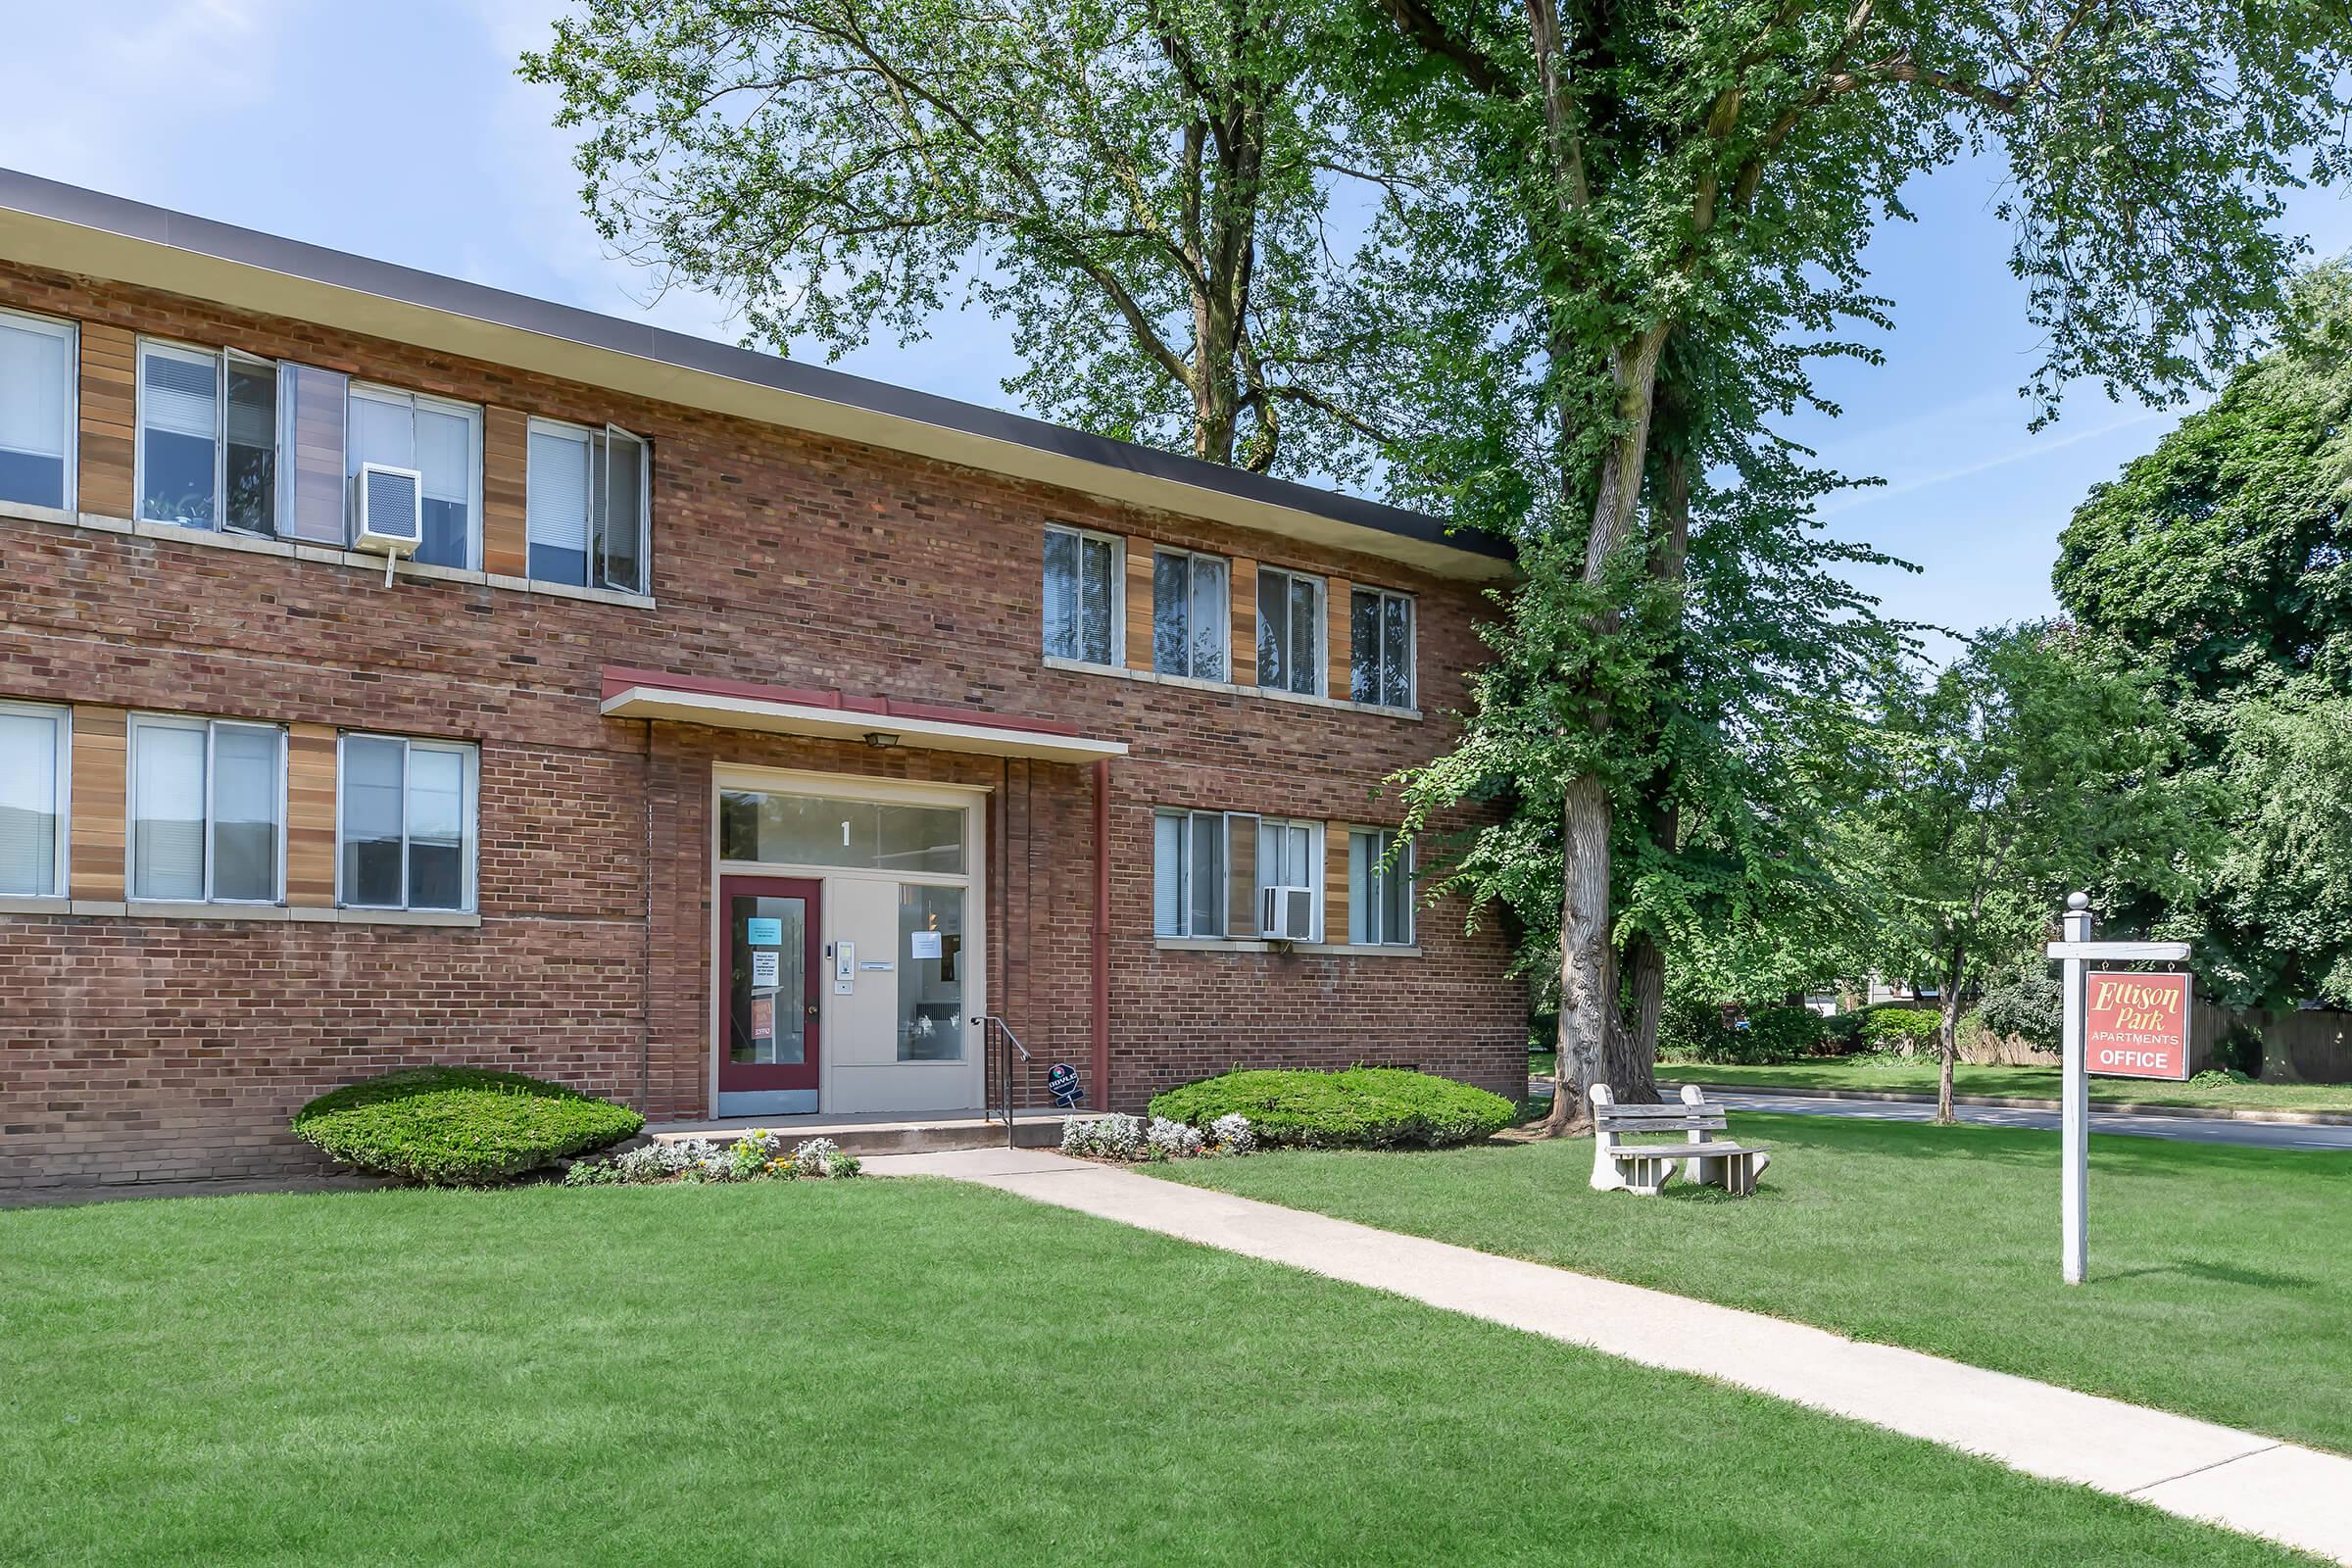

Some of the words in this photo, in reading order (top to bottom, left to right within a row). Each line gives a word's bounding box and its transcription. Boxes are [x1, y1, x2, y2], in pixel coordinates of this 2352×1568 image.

[841, 821, 851, 847] 1
[2091, 982, 2180, 1014] Ellison
[2115, 1006, 2166, 1031] Park
[2091, 1031, 2180, 1046] APARTMENTS
[2100, 1050, 2168, 1069] OFFICE
